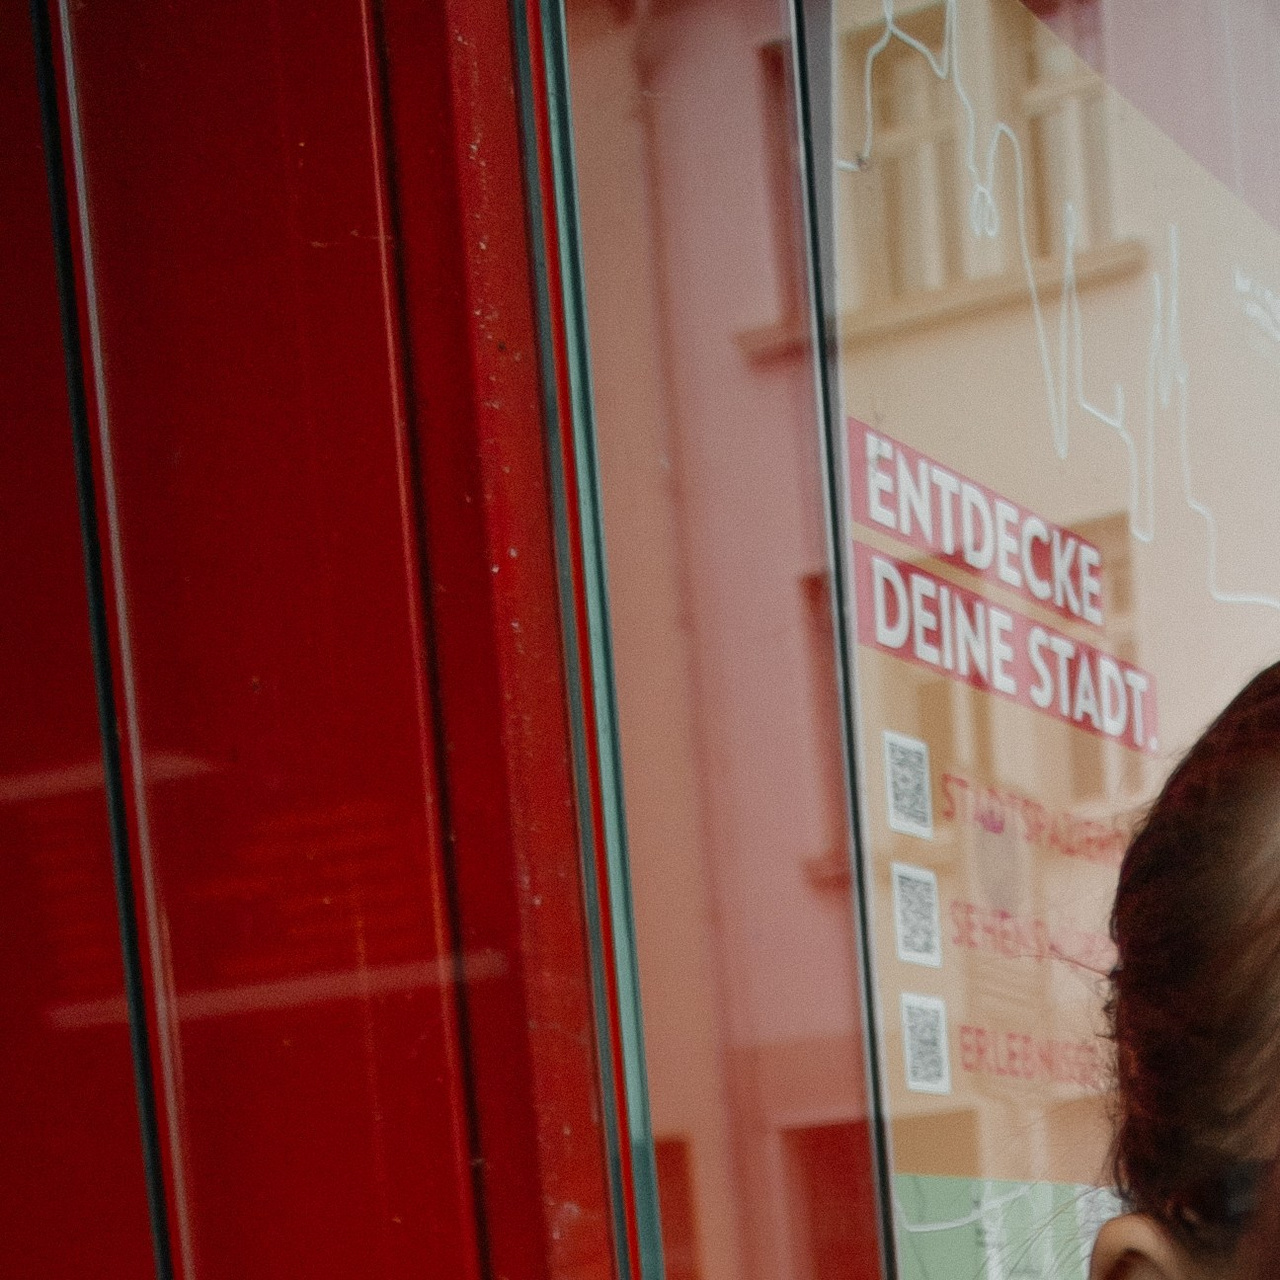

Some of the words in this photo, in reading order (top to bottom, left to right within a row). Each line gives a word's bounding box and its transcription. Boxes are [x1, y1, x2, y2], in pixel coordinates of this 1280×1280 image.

[866, 430, 1104, 627] ENTDECKE
[872, 555, 1017, 696] DEINE
[1027, 626, 1158, 750] STADT.
